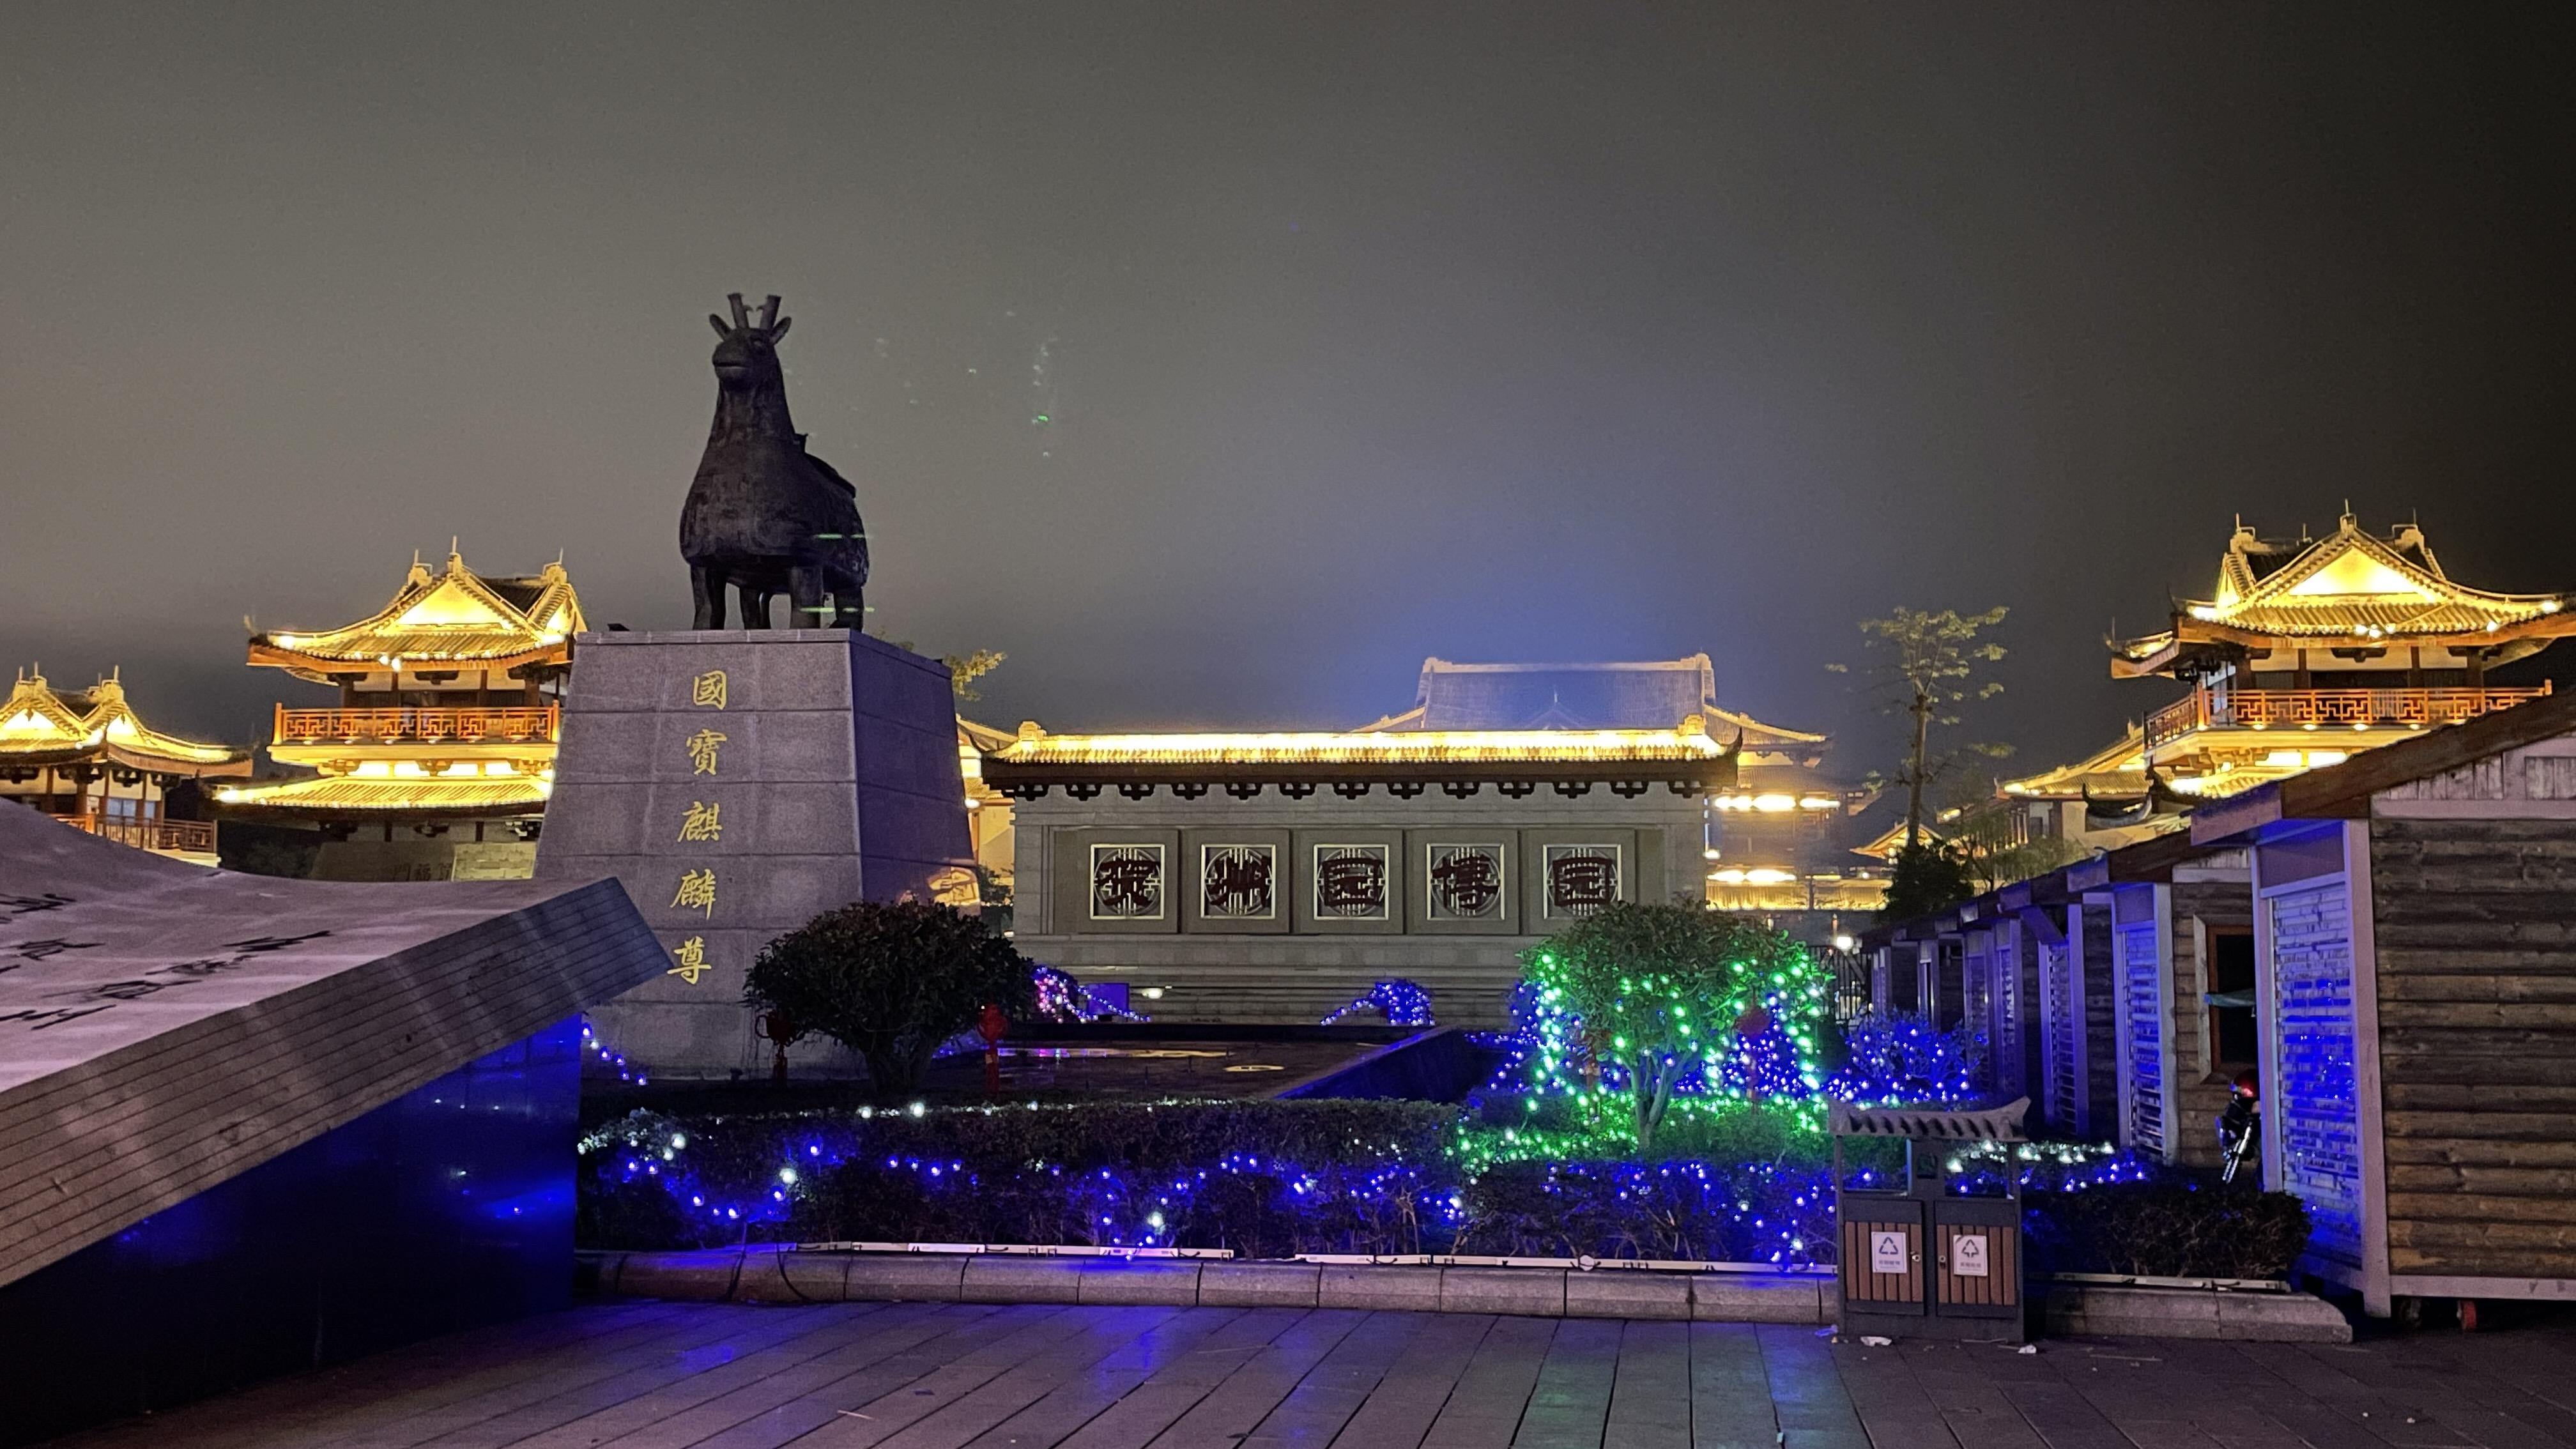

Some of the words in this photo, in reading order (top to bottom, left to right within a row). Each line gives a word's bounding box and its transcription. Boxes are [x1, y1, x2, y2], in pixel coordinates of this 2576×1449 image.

[667, 670, 727, 984] 國寶麒麟尊
